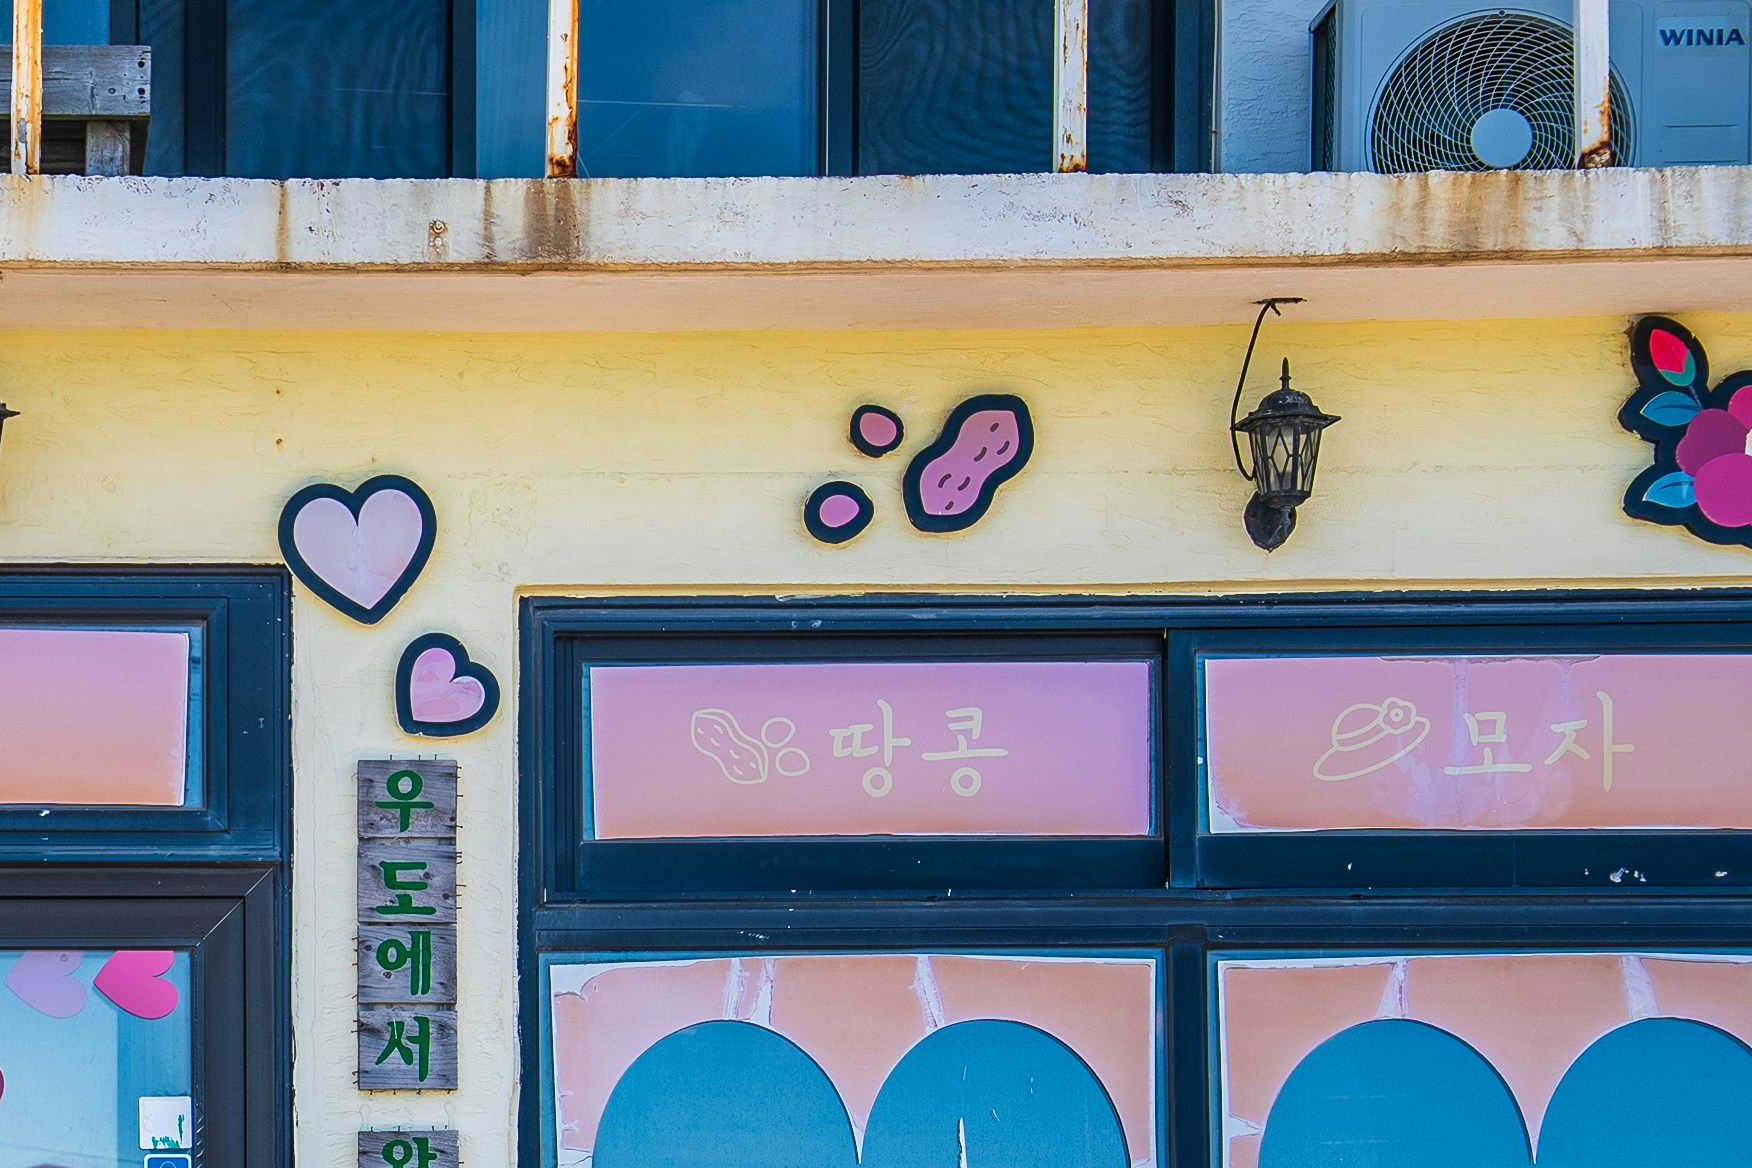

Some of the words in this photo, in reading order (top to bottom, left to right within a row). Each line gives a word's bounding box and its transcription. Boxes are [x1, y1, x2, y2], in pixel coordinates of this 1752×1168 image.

[1660, 28, 1745, 46] WINIA
[829, 700, 1008, 797] 땅콩
[1443, 691, 1635, 792] 모자
[375, 769, 437, 1083] 우도에서
